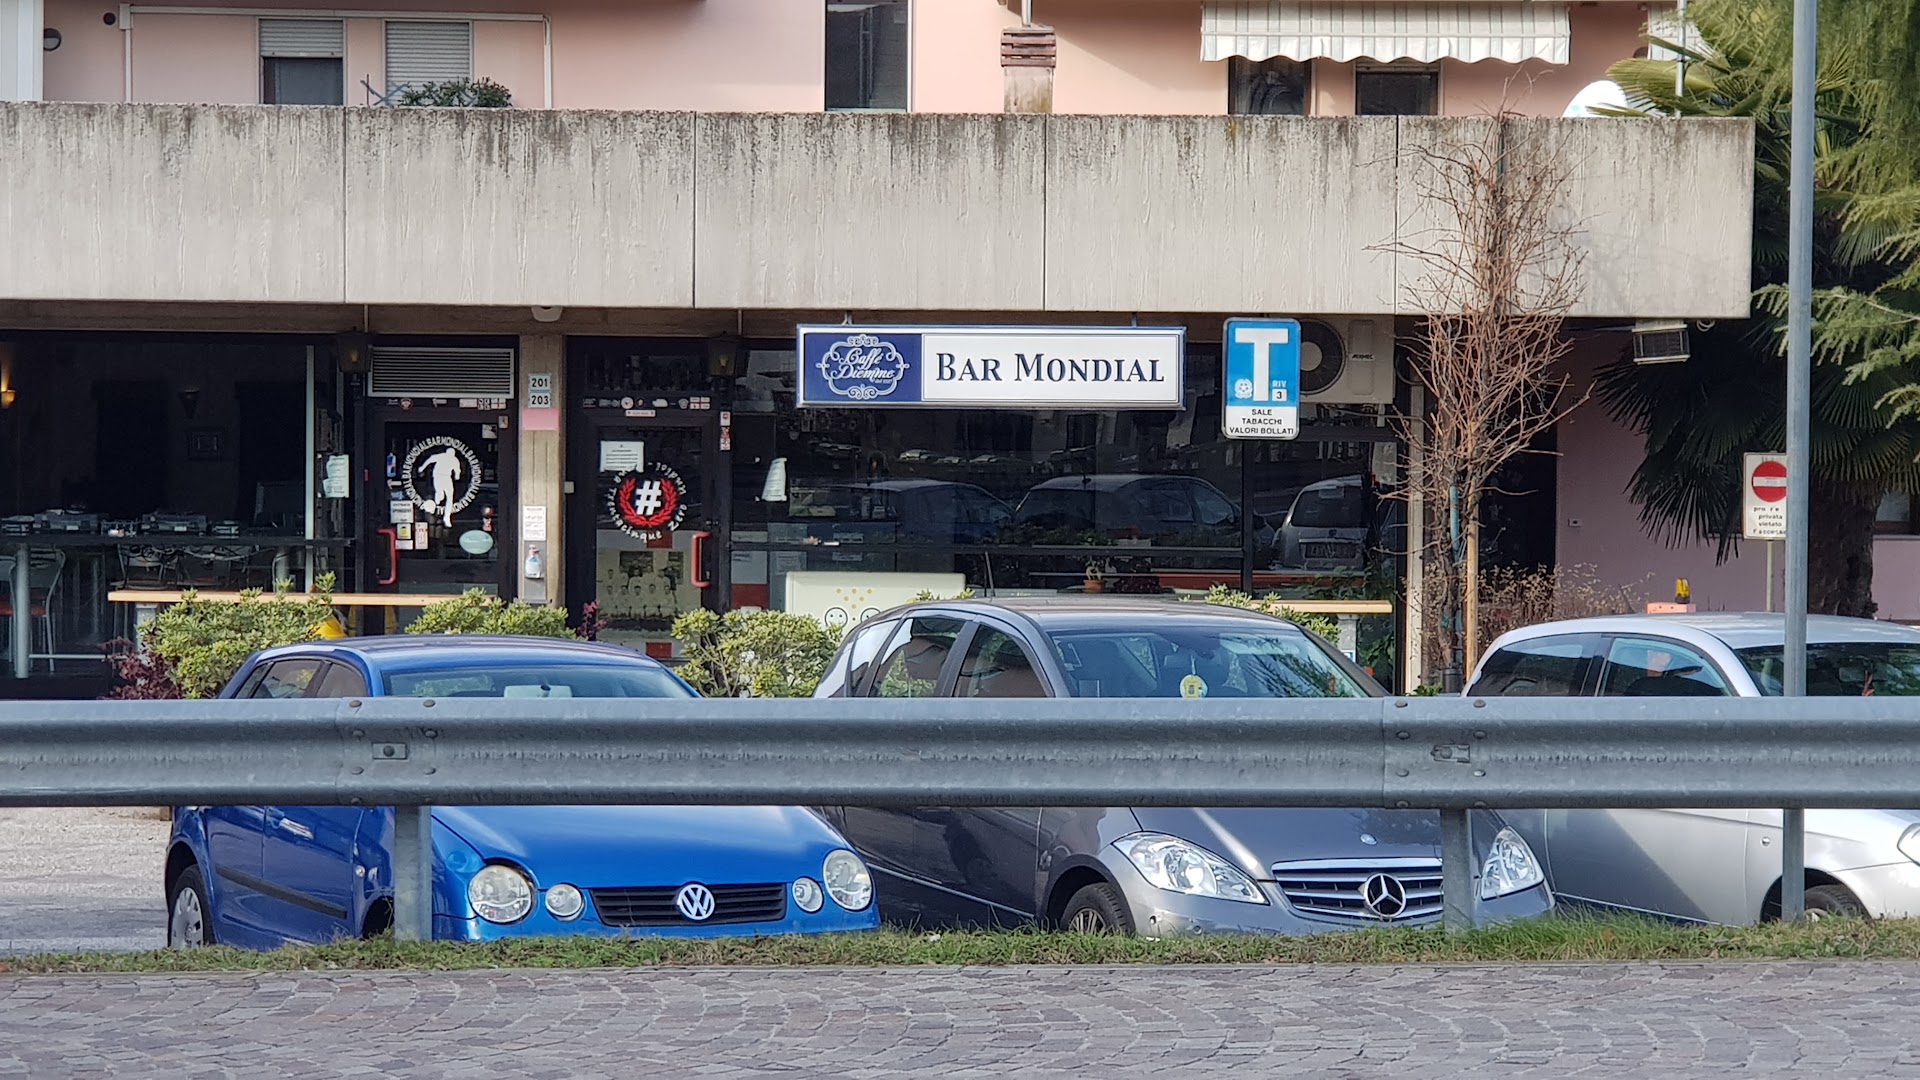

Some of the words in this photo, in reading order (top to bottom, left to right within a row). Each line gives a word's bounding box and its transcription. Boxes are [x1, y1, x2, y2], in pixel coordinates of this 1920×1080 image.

[936, 352, 1003, 382] BAR
[1014, 352, 1165, 383] MONDIAL
[531, 377, 548, 388] 201
[1271, 379, 1287, 388] RIV
[1276, 390, 1283, 400] 3
[531, 395, 549, 405] 203
[1251, 408, 1273, 416] SALE
[1241, 417, 1283, 425] TABACCHI
[1229, 426, 1259, 434] VALORI
[1260, 427, 1294, 435] BOLLATI
